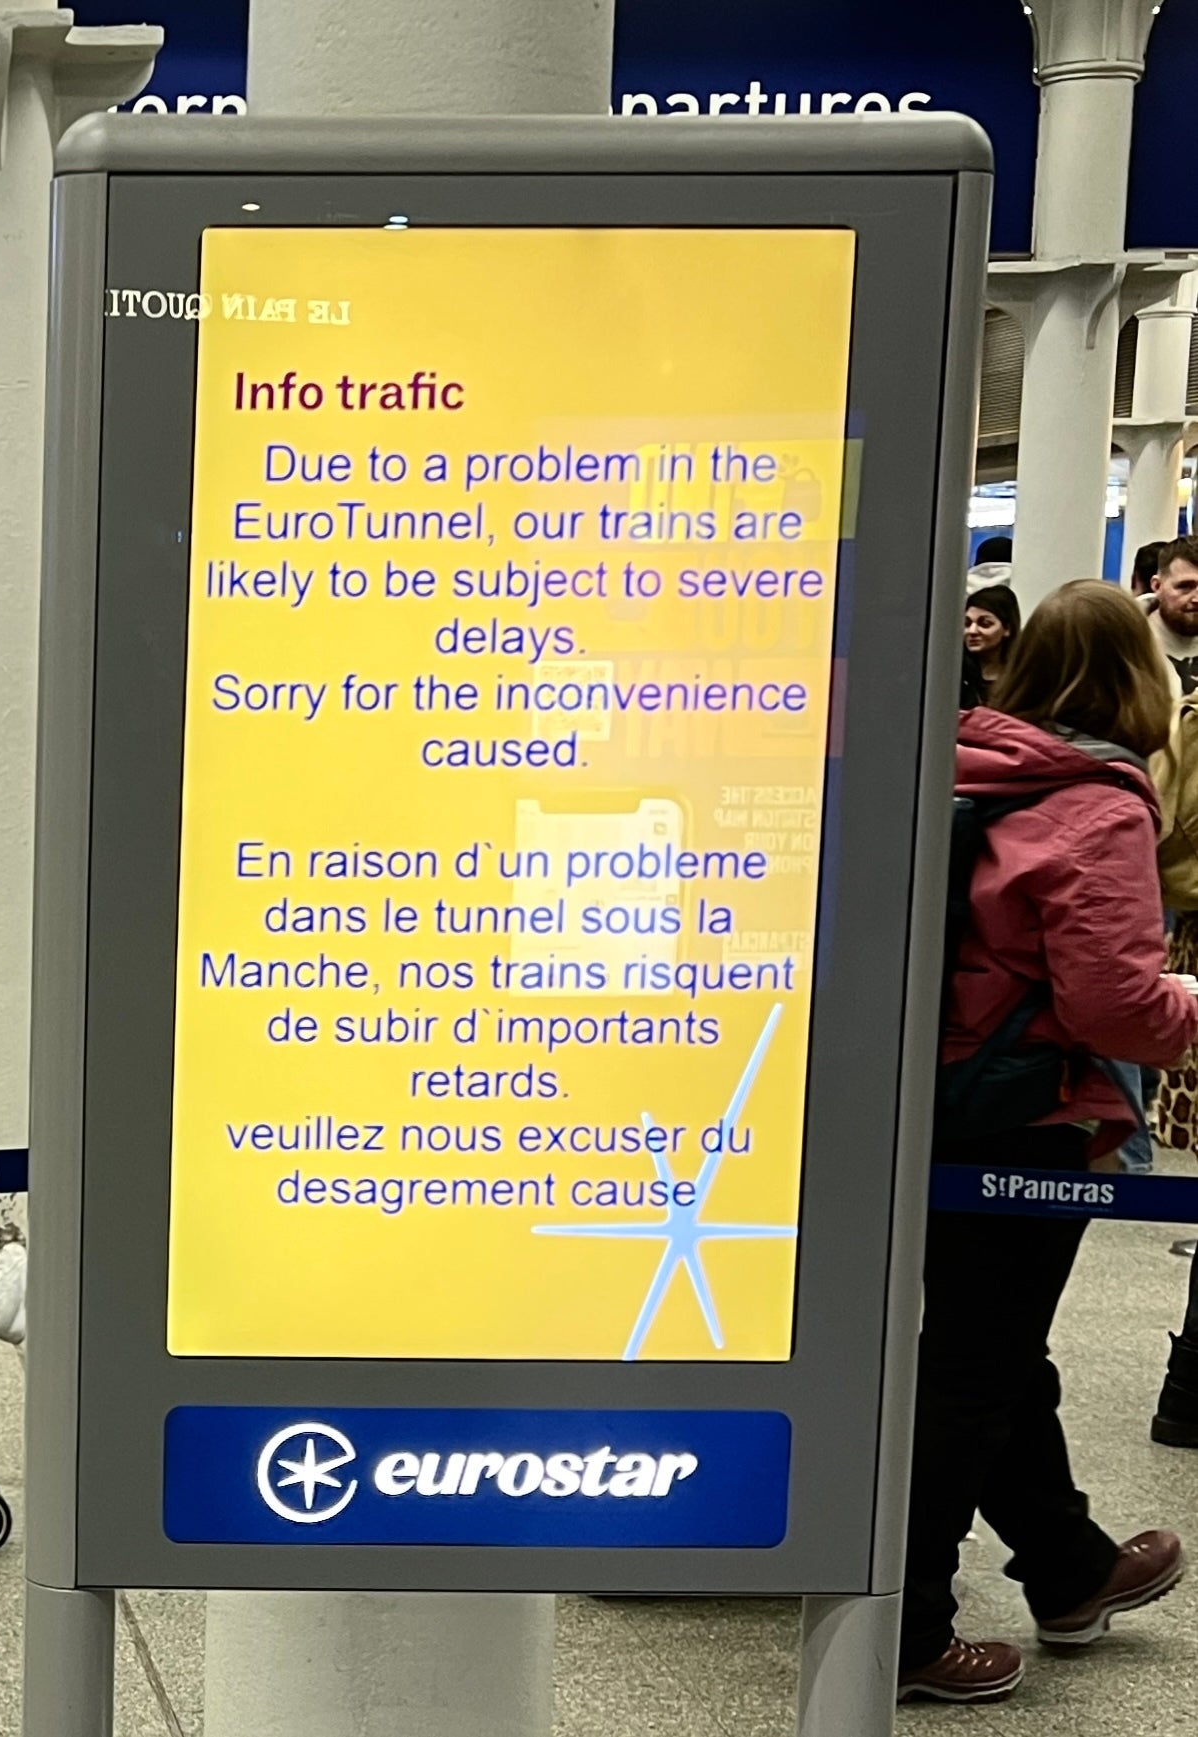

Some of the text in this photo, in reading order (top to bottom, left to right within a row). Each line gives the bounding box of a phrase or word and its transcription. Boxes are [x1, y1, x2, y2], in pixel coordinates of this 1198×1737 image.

[236, 372, 463, 409] Info trafic
[266, 445, 775, 491] Due to a problem in the
[235, 503, 801, 545] EuroTunnel, our trains are
[208, 561, 822, 607] likely to be subject to severe
[436, 618, 584, 664] delays.
[213, 674, 807, 720] Sorry for the inconvenience
[422, 731, 588, 768] caused.
[238, 843, 290, 877] En
[310, 843, 436, 877] raison
[568, 844, 766, 886] probleme
[265, 898, 731, 934] dans le tunnel sous la
[202, 953, 793, 998] Manche, nos trains risquent
[268, 1008, 317, 1042] de
[336, 1008, 438, 1042] subir
[412, 1064, 568, 1097] retards.
[227, 1116, 751, 1153] veuillez nous excuser du
[278, 1170, 697, 1214] desagrement cause
[373, 1445, 698, 1498] eurostar
